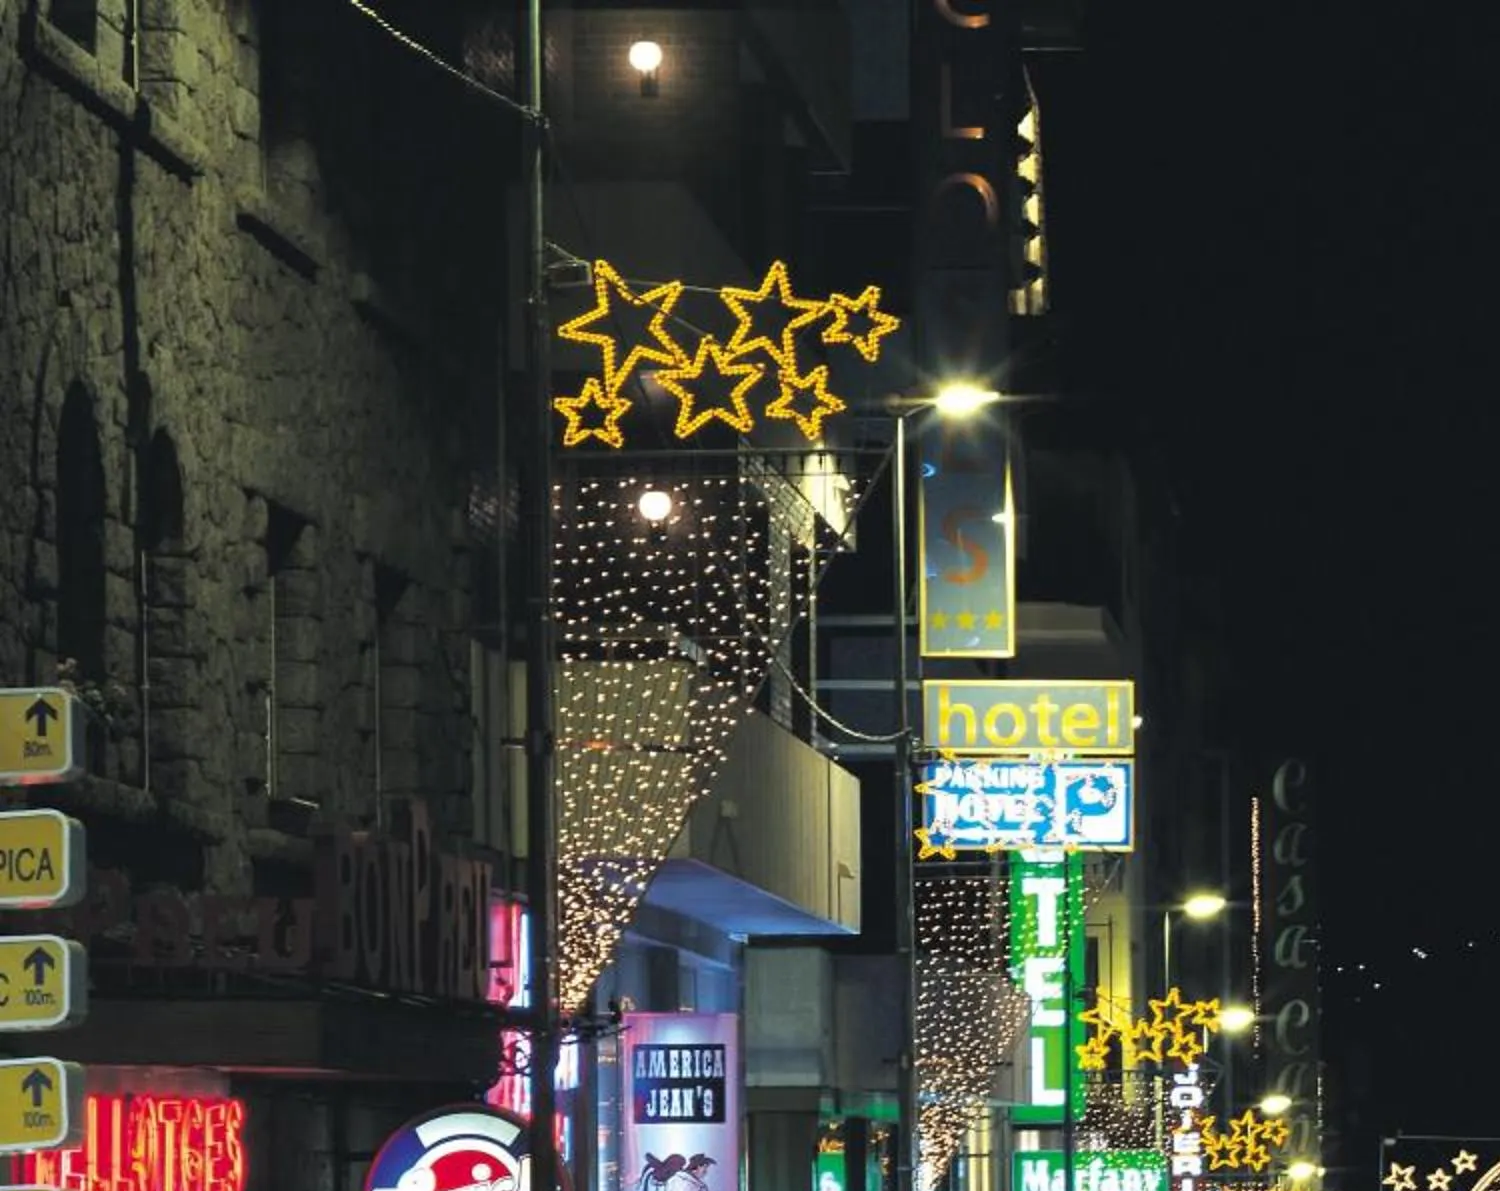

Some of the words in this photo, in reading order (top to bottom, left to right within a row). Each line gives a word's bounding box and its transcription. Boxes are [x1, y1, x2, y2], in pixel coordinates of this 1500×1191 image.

[939, 684, 1120, 747] hotel
[636, 1049, 724, 1080] AMERICA
[645, 1085, 713, 1118] JEAN'S
